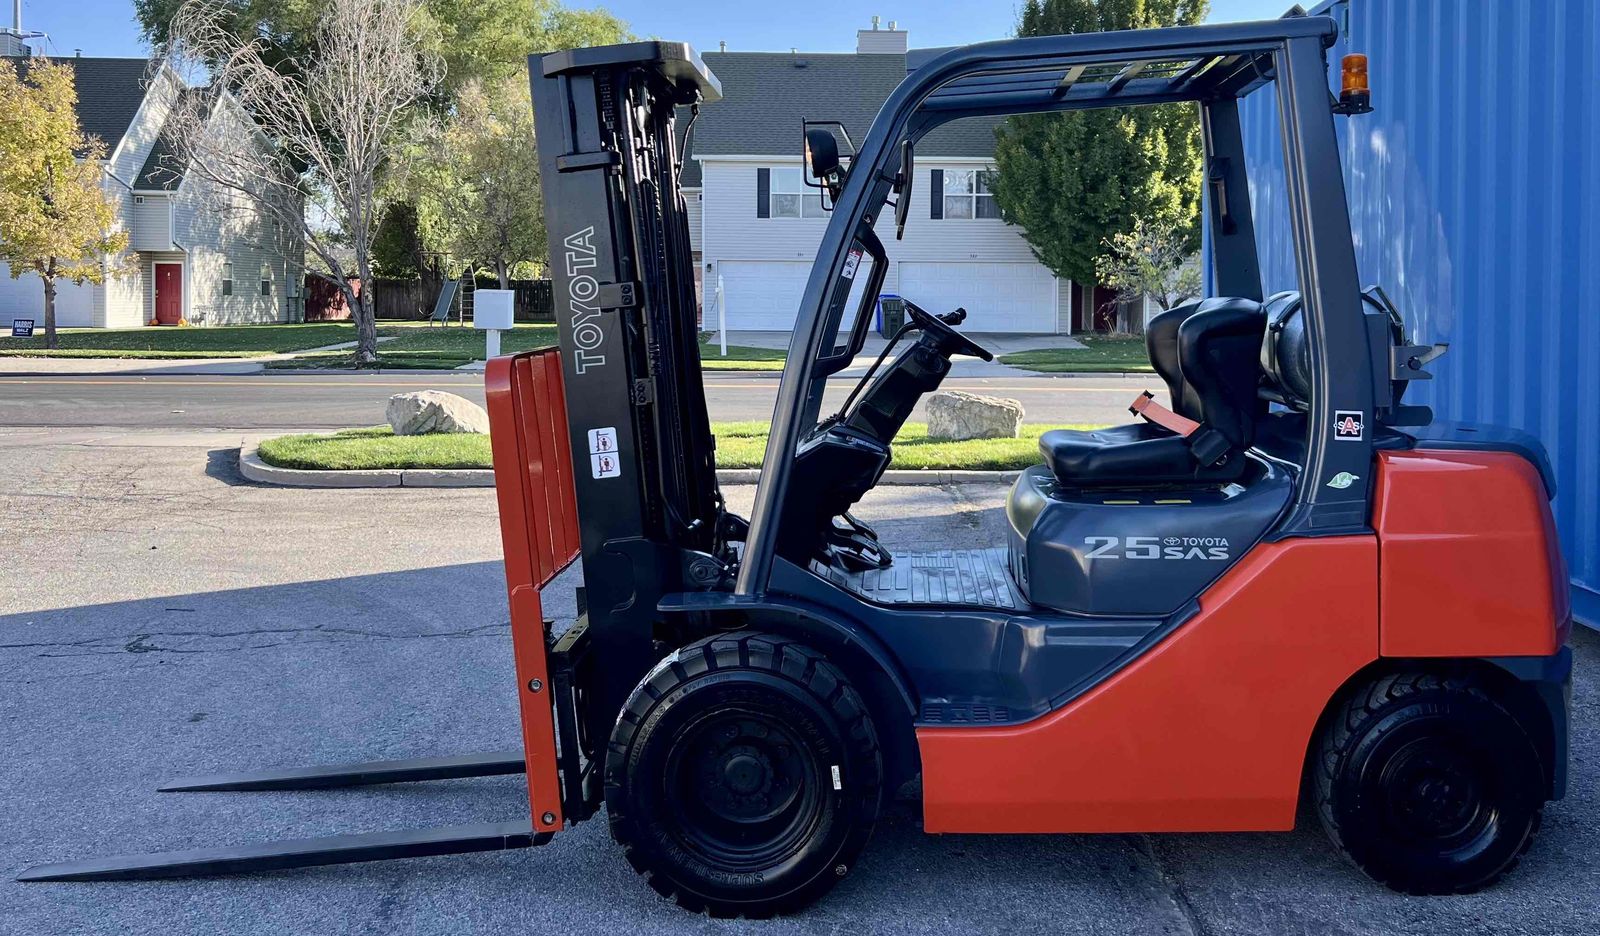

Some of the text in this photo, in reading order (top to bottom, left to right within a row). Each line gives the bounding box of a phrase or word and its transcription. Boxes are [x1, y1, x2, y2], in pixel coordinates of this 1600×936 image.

[564, 225, 606, 374] TOYOTA
[14, 320, 33, 328] HARRIS
[1084, 536, 1160, 560] 25
[1182, 537, 1229, 546] TOYOTA
[1164, 547, 1229, 560] SAS
